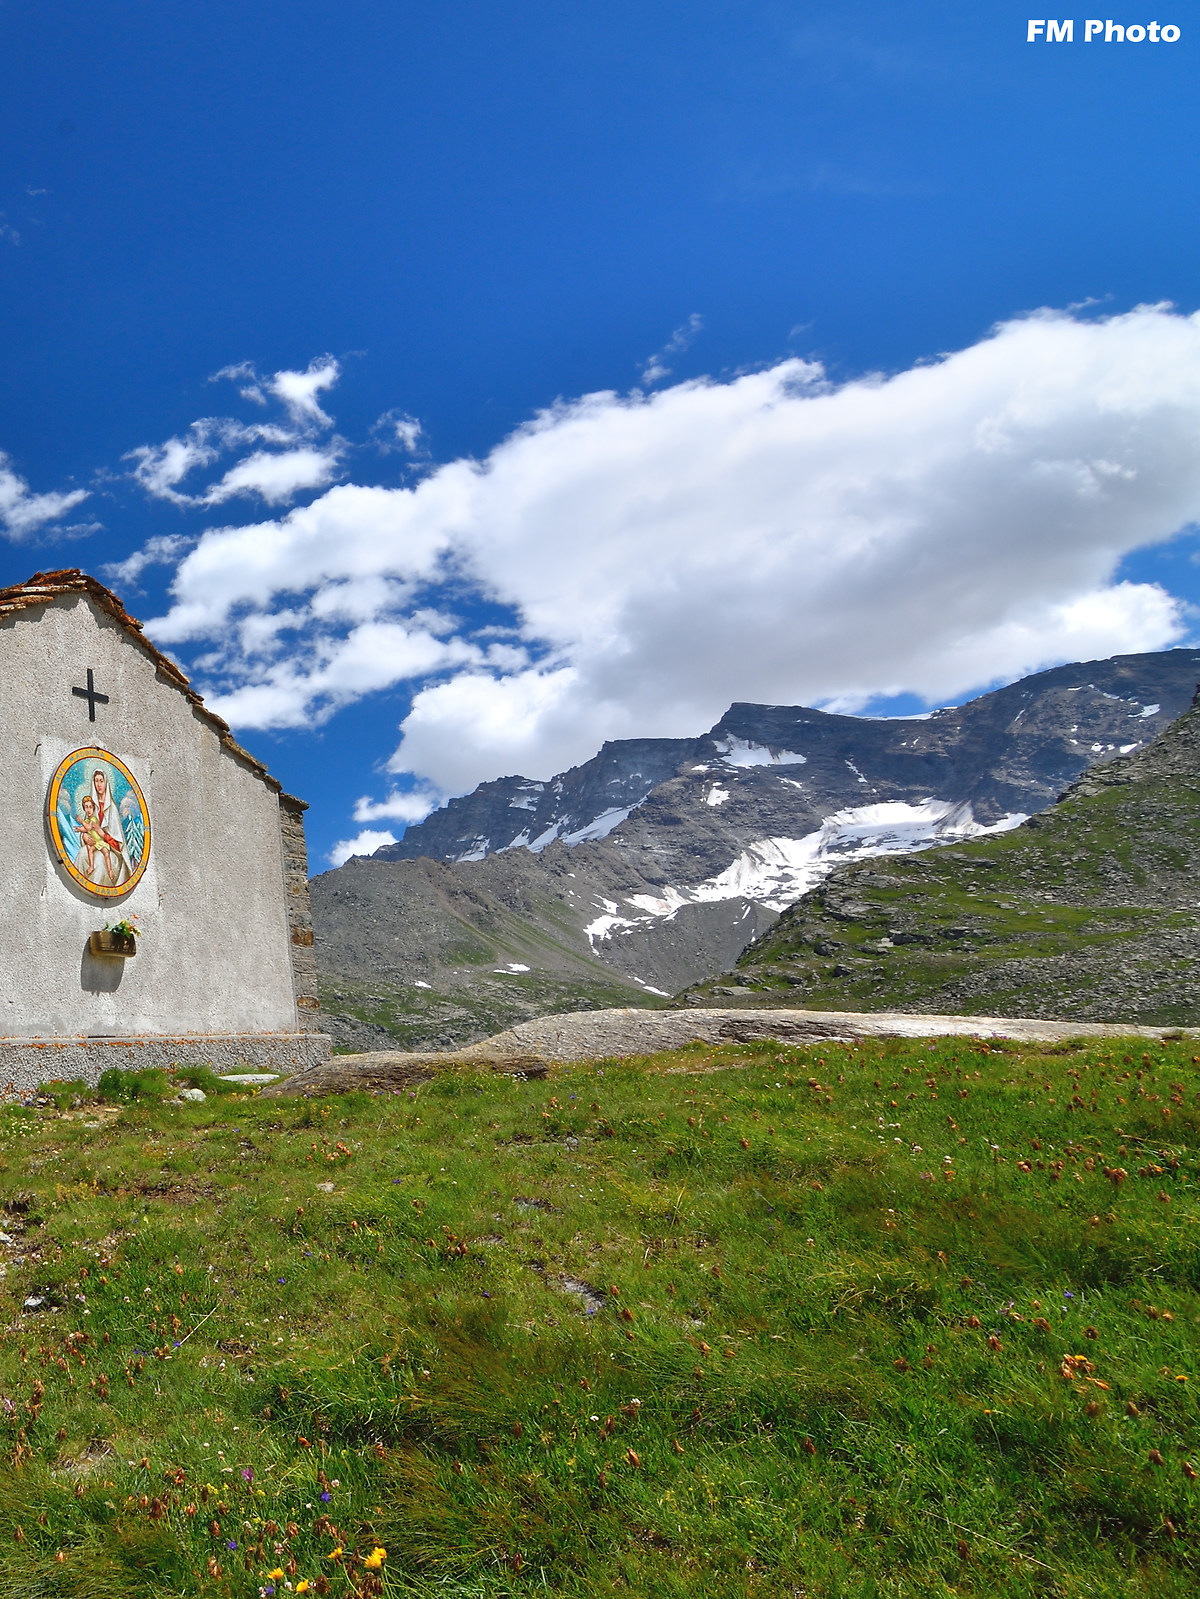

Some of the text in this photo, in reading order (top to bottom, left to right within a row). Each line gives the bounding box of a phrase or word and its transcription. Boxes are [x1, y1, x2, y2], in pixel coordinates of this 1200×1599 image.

[56, 765, 66, 783] AVE
[69, 749, 105, 764] MADONNA
[95, 886, 118, 895] DARIO
